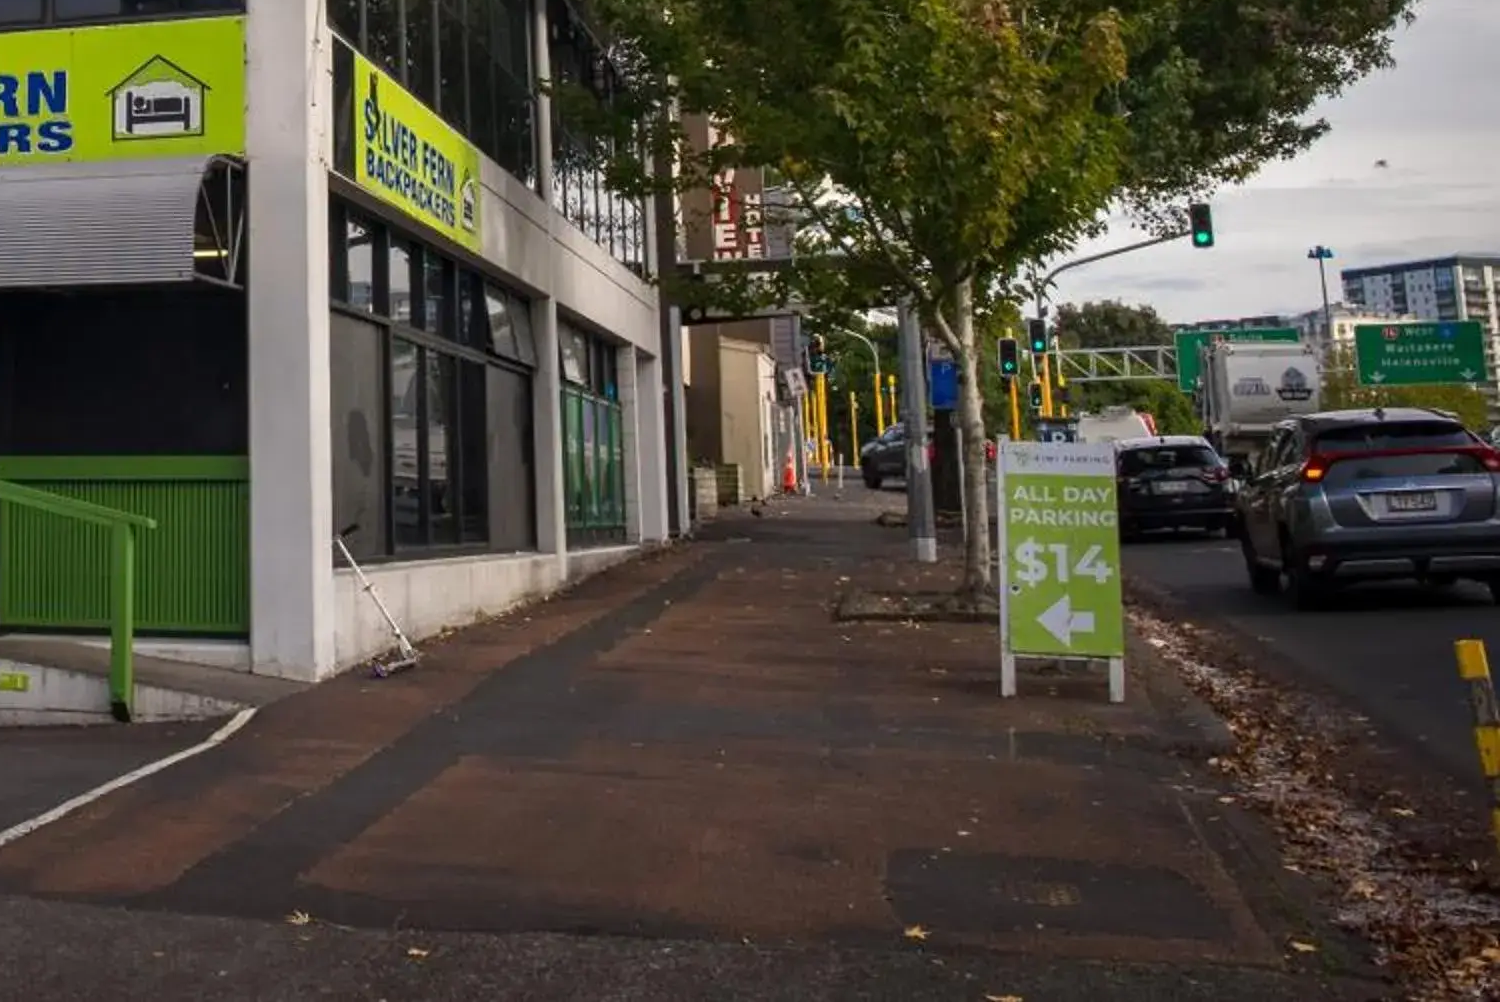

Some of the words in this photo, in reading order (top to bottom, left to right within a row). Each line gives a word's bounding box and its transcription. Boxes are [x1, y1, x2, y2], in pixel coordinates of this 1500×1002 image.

[366, 147, 456, 227] BACKPACKERS
[423, 142, 456, 195] FERN
[1009, 507, 1117, 527] PARKING
[1012, 485, 1057, 502] ALL
[1063, 486, 1112, 503] DAY
[1014, 535, 1114, 587] $14
